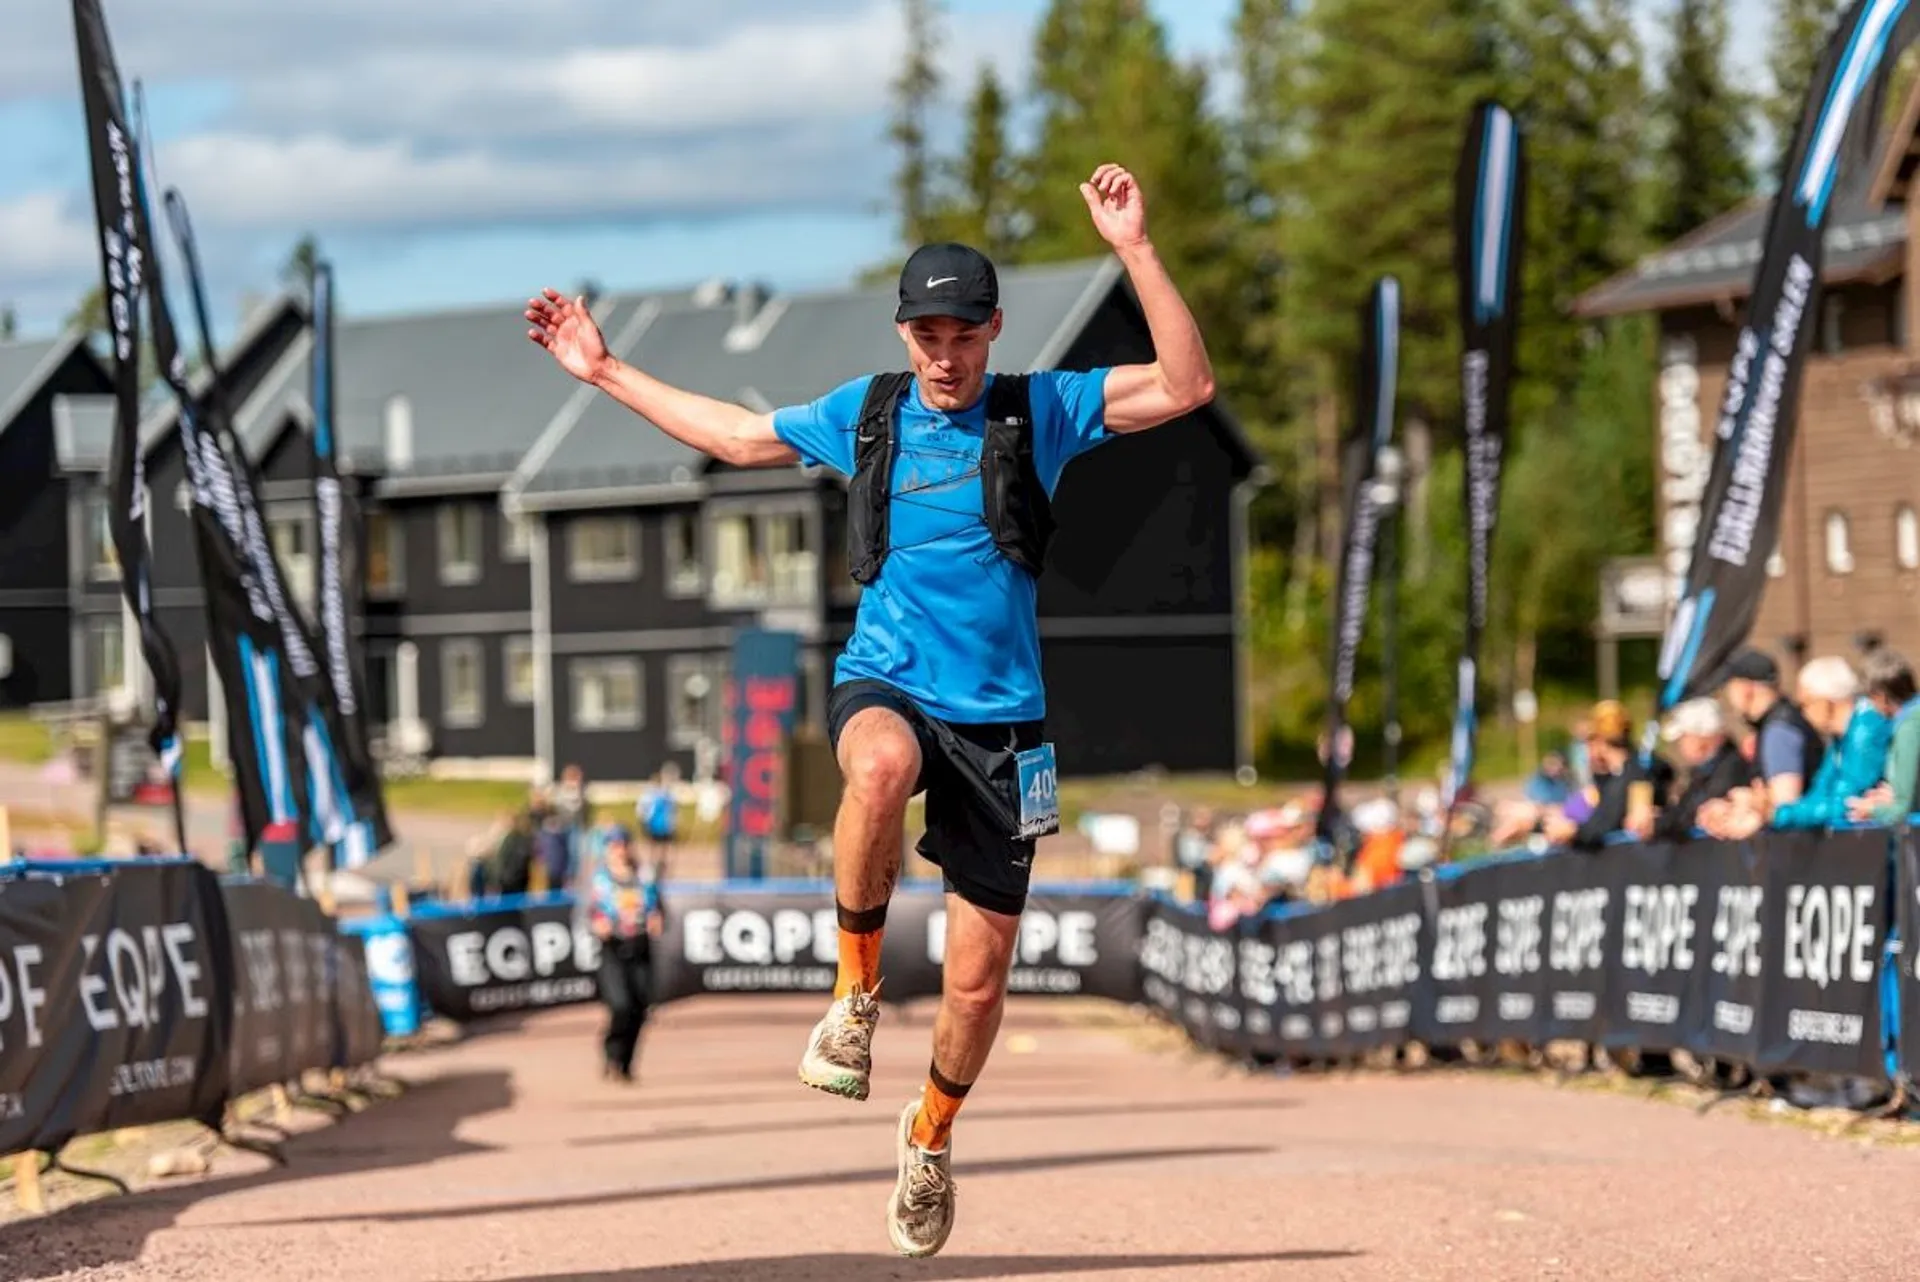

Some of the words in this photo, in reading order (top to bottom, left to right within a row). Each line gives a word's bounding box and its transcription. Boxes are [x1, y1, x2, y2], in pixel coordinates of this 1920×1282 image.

[79, 922, 209, 1032] EQPE
[446, 921, 603, 986] EQPE
[684, 909, 837, 966] EQPE
[1784, 885, 1875, 990] EQPE
